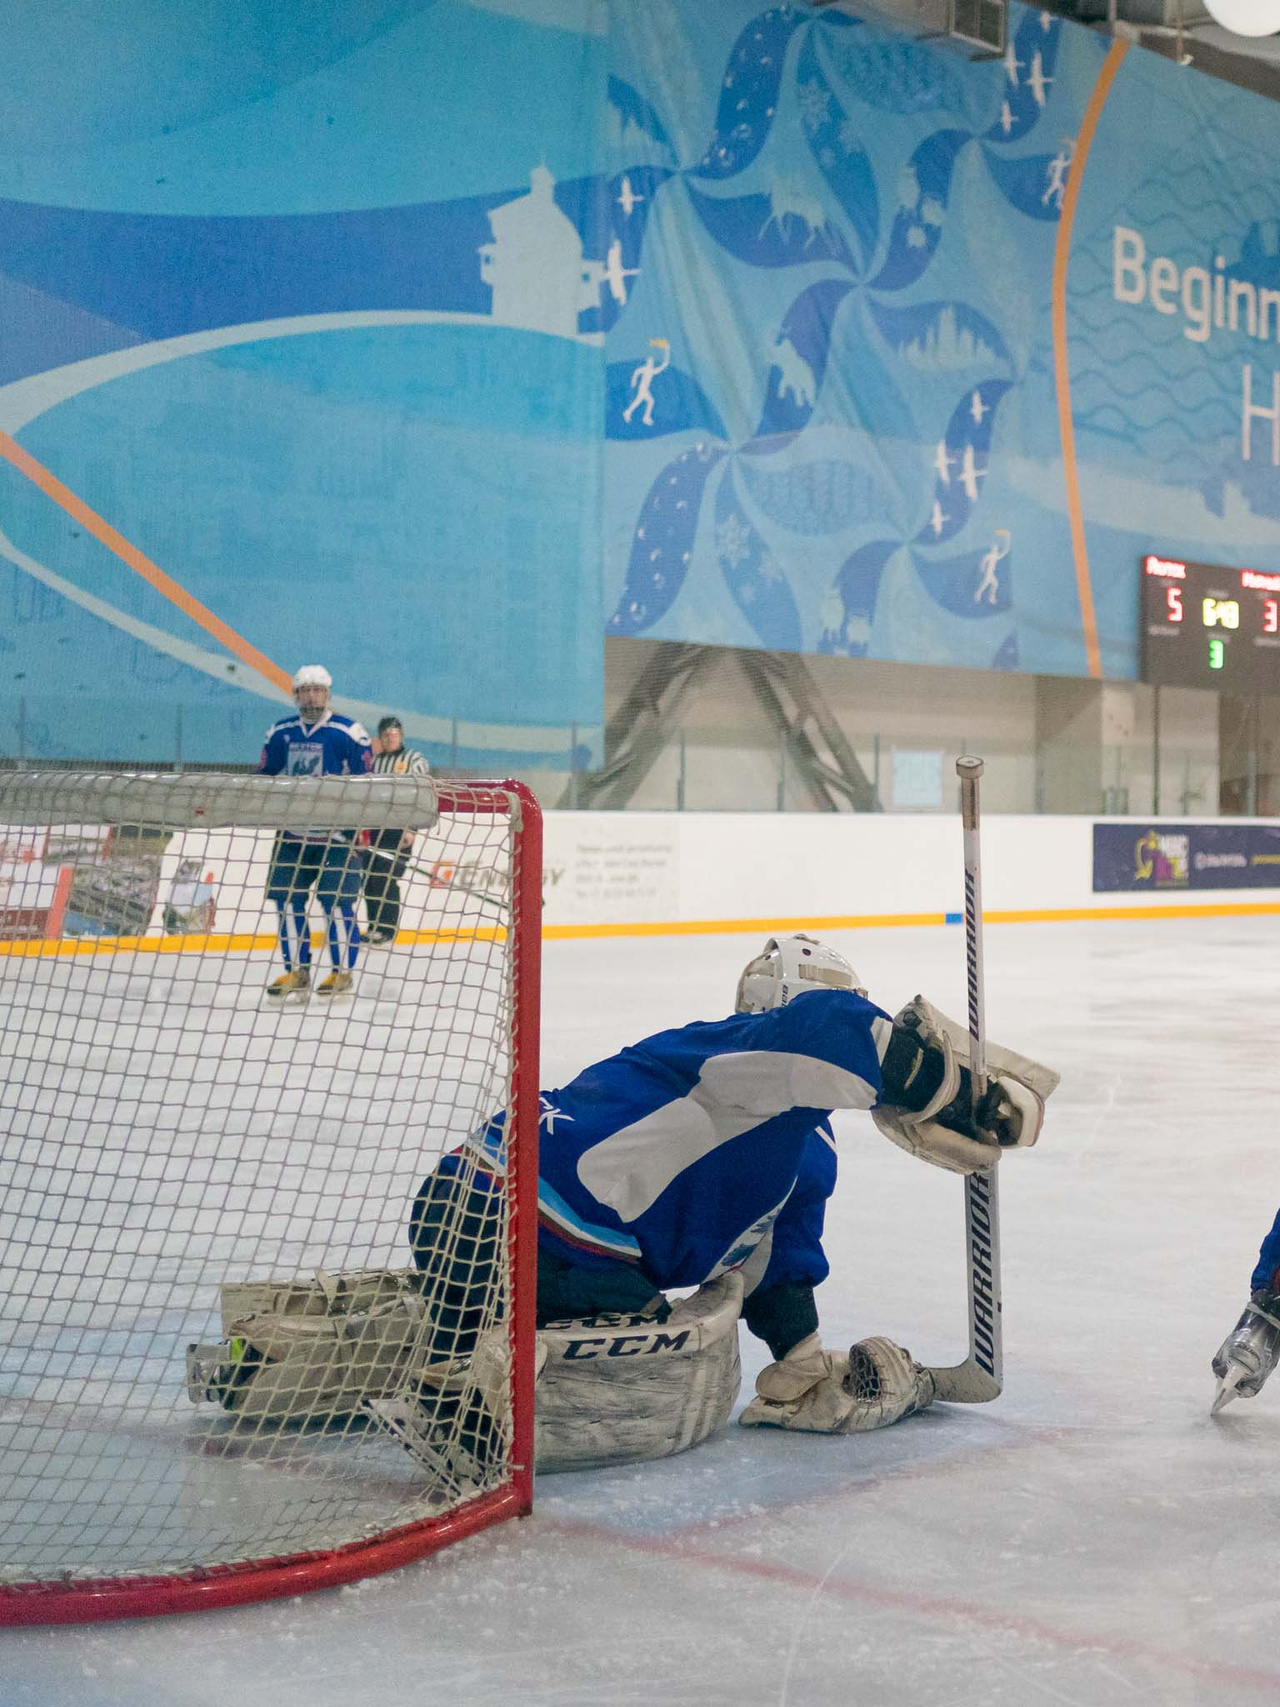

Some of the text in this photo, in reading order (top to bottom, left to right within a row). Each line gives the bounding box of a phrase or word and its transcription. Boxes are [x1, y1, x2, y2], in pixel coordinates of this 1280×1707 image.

[1166, 586, 1183, 622] 5
[1262, 599, 1279, 634] 3
[1208, 640, 1224, 669] 3
[969, 1170, 995, 1378] WARRIOR
[562, 1330, 691, 1361] CCM
